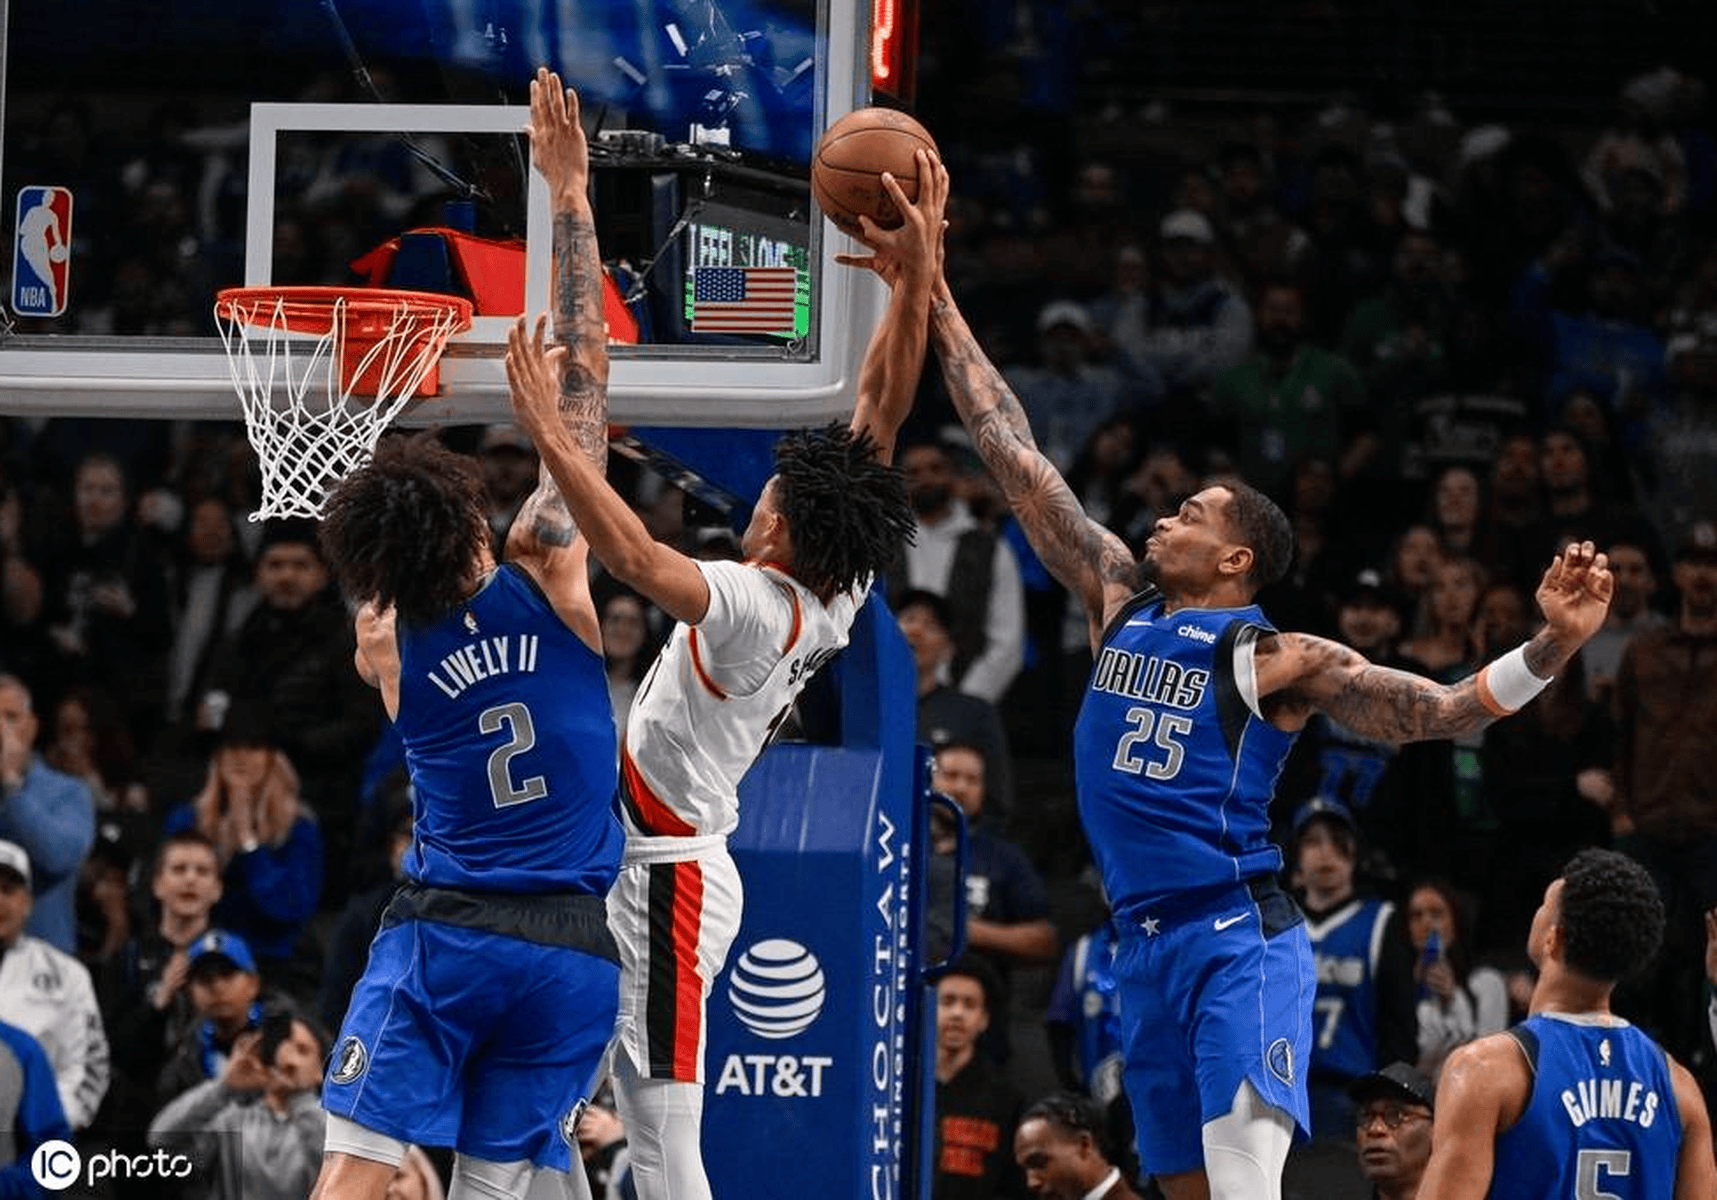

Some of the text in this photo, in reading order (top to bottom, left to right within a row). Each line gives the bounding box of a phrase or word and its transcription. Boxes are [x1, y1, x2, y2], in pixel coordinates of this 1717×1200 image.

[20, 286, 46, 308] NBA
[1177, 624, 1217, 644] chime
[427, 634, 538, 699] LIVELY II
[1092, 646, 1210, 710] DALLAS
[478, 702, 548, 809] 2
[1111, 706, 1193, 781] 25
[715, 1053, 833, 1098] AT&T
